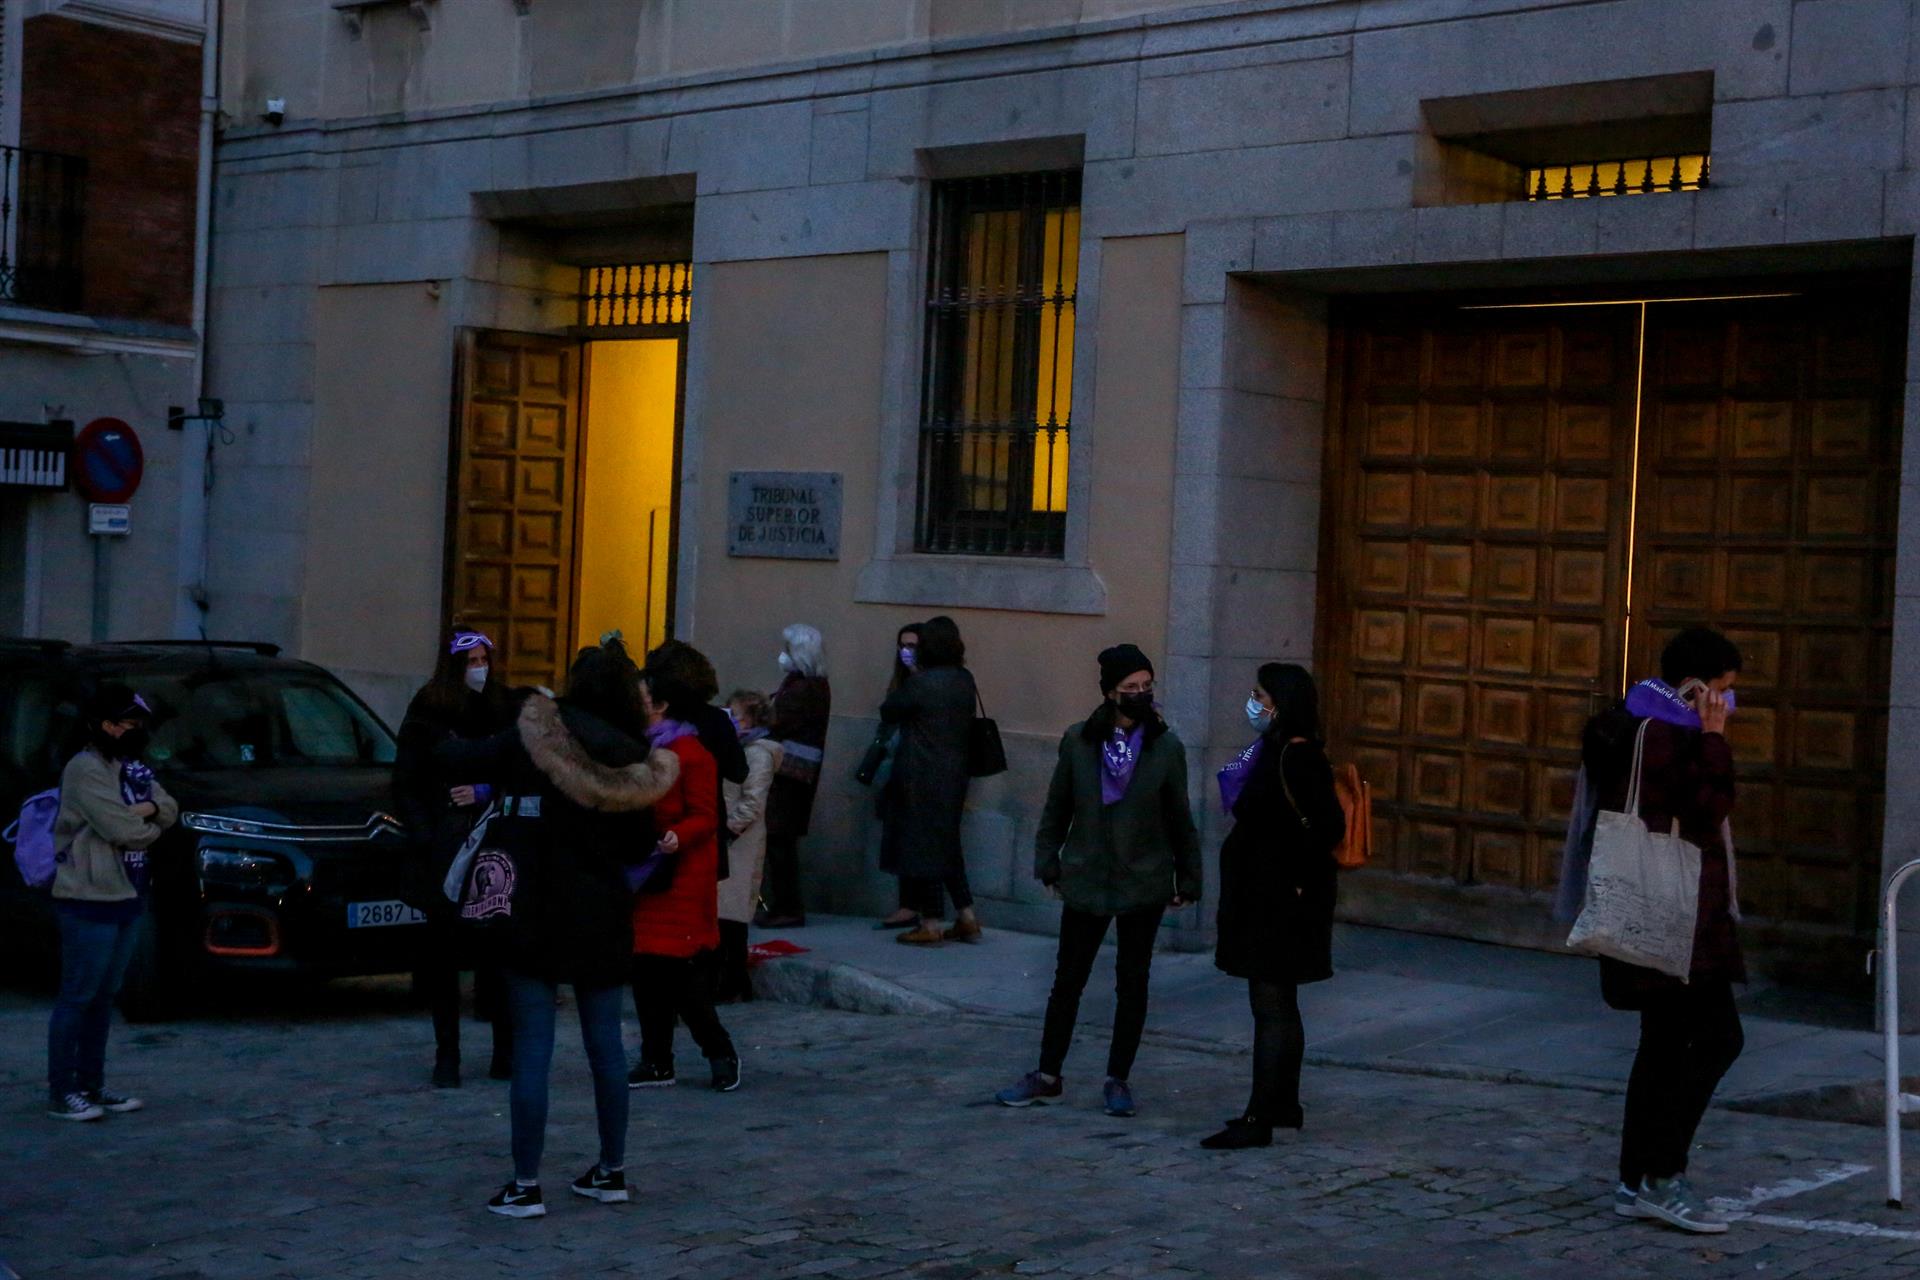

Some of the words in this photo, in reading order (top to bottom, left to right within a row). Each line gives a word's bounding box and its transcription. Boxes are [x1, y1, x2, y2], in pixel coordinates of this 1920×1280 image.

[752, 486, 817, 505] TRIBUNAL
[746, 506, 820, 525] SUPERIOR
[738, 525, 756, 542] DE
[758, 526, 826, 545] JUSTICIA
[361, 904, 404, 924] 2687
